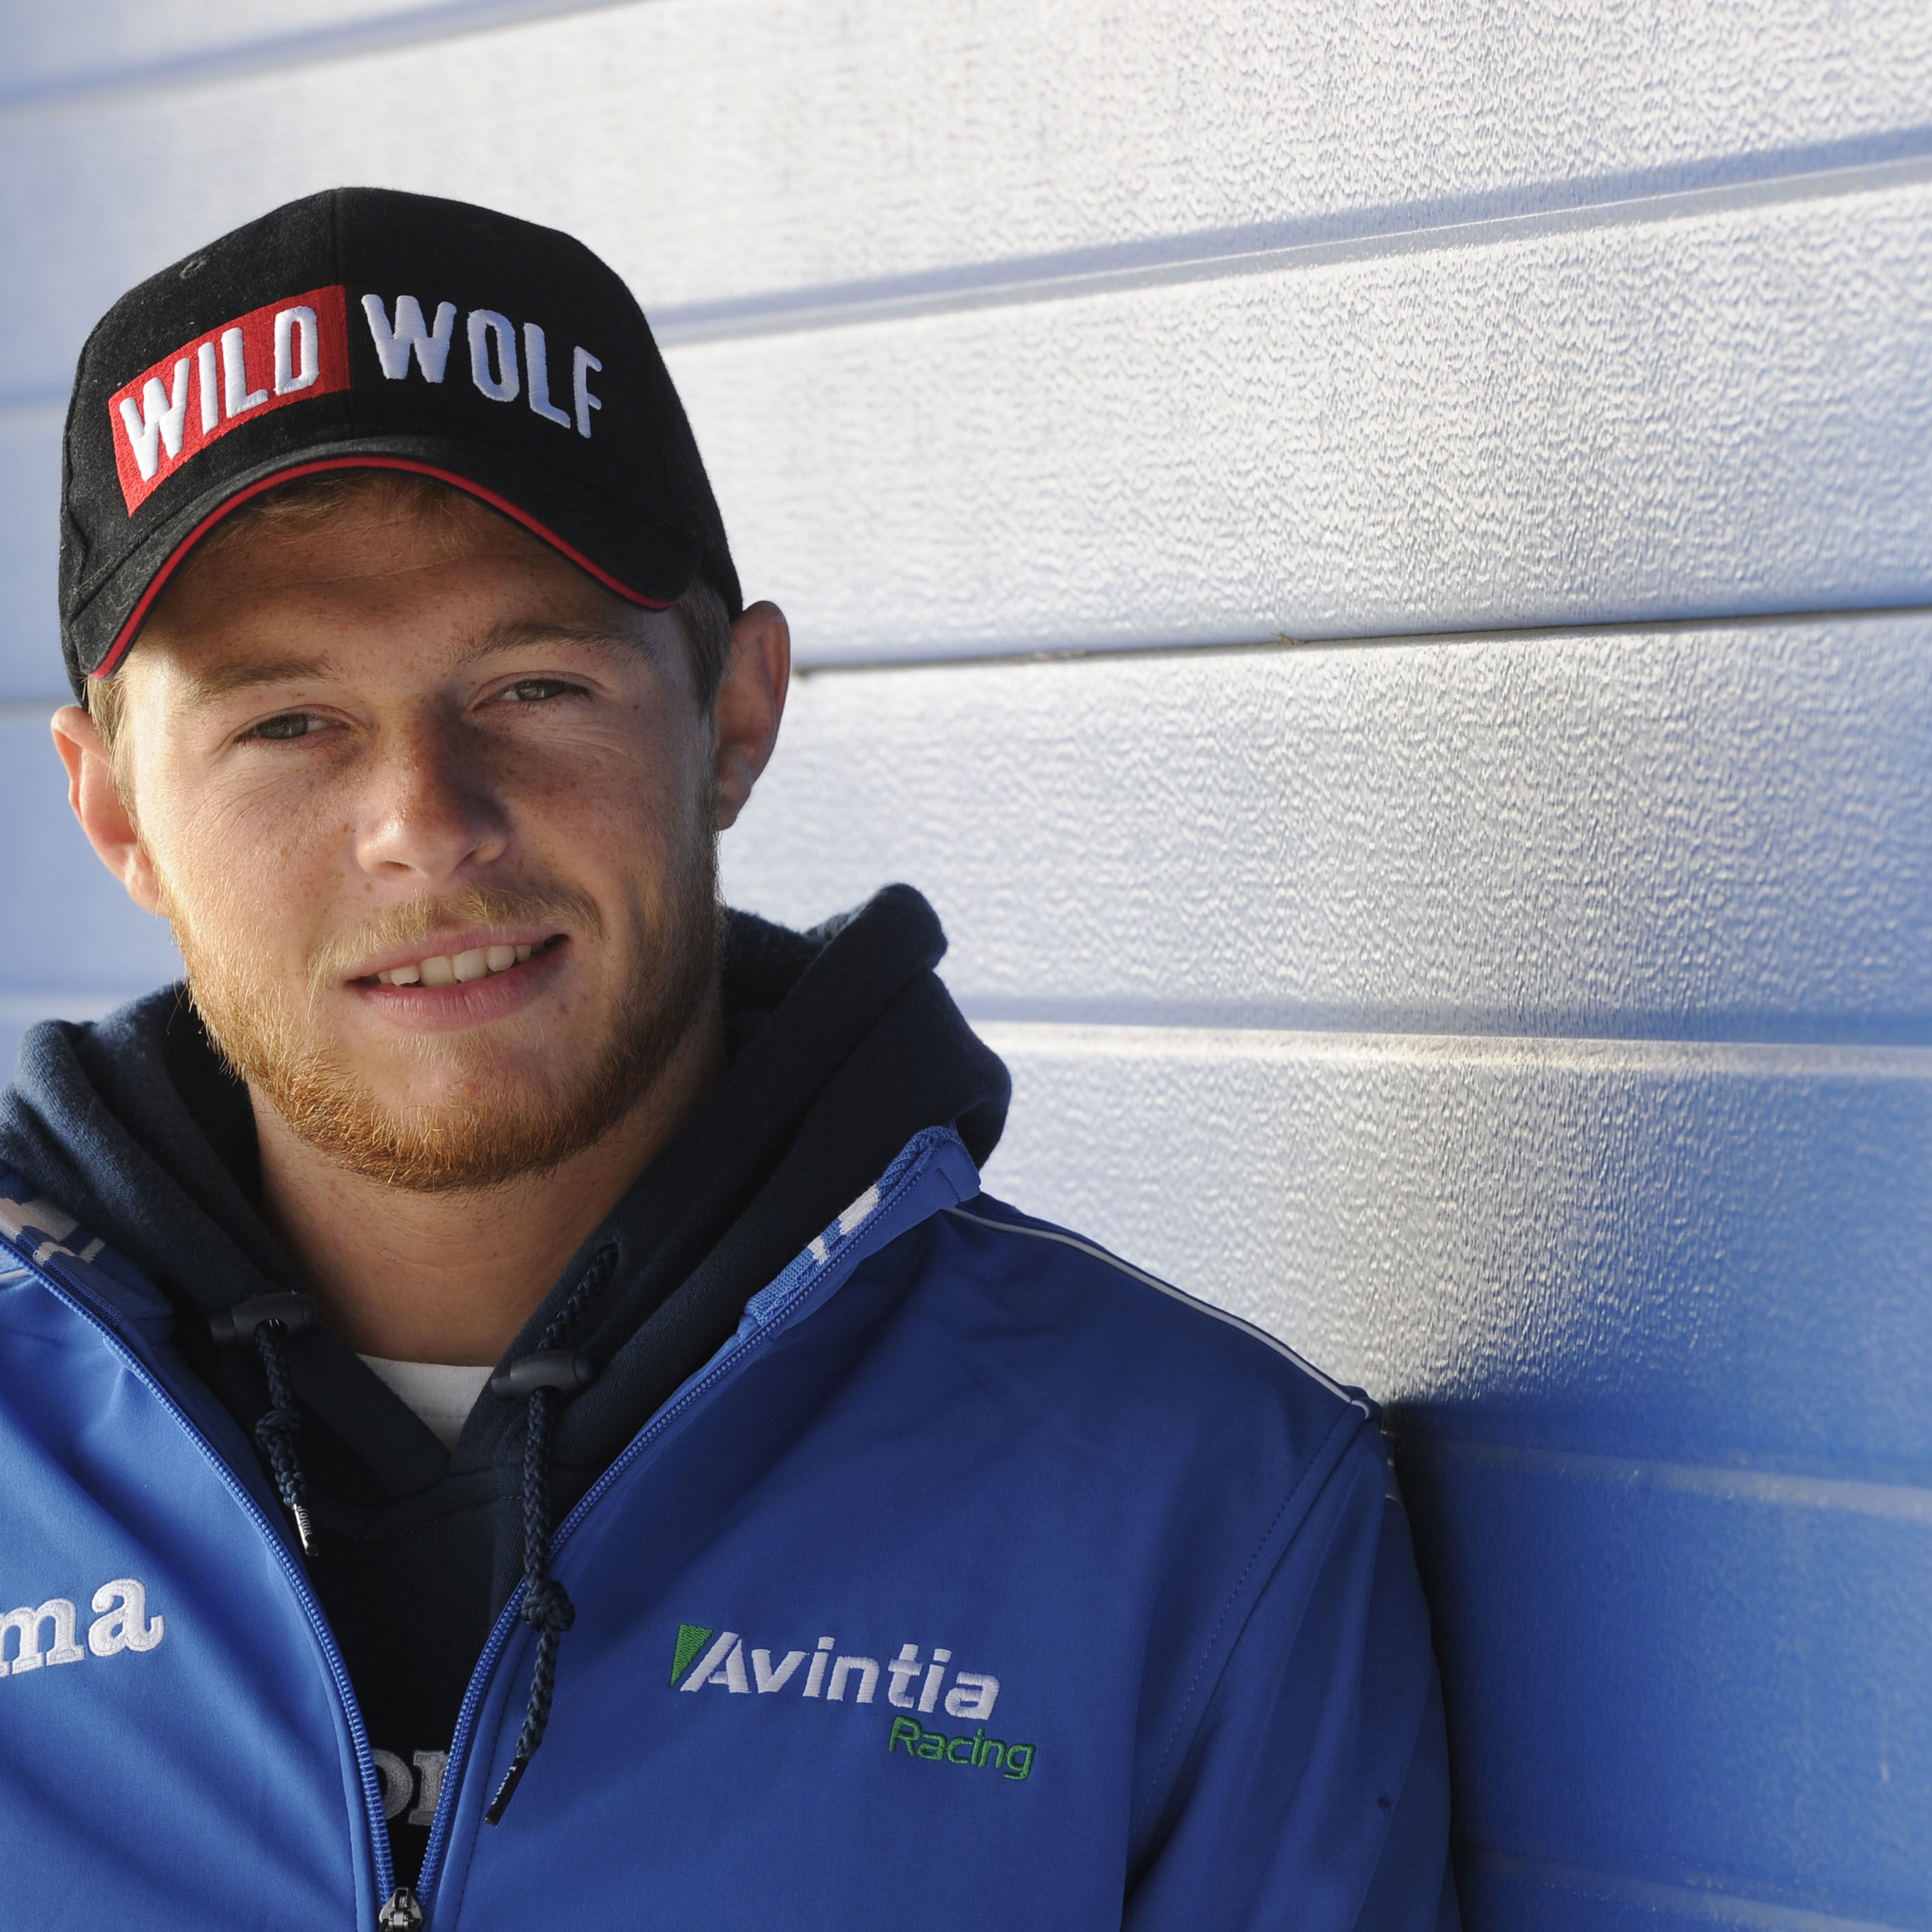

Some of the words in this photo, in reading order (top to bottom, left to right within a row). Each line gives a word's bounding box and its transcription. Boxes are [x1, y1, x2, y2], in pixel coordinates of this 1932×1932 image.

[119, 306, 319, 482] WILD
[362, 294, 602, 438] WOLF
[679, 1631, 999, 1720] Avintia
[889, 1716, 1036, 1780] Racing
